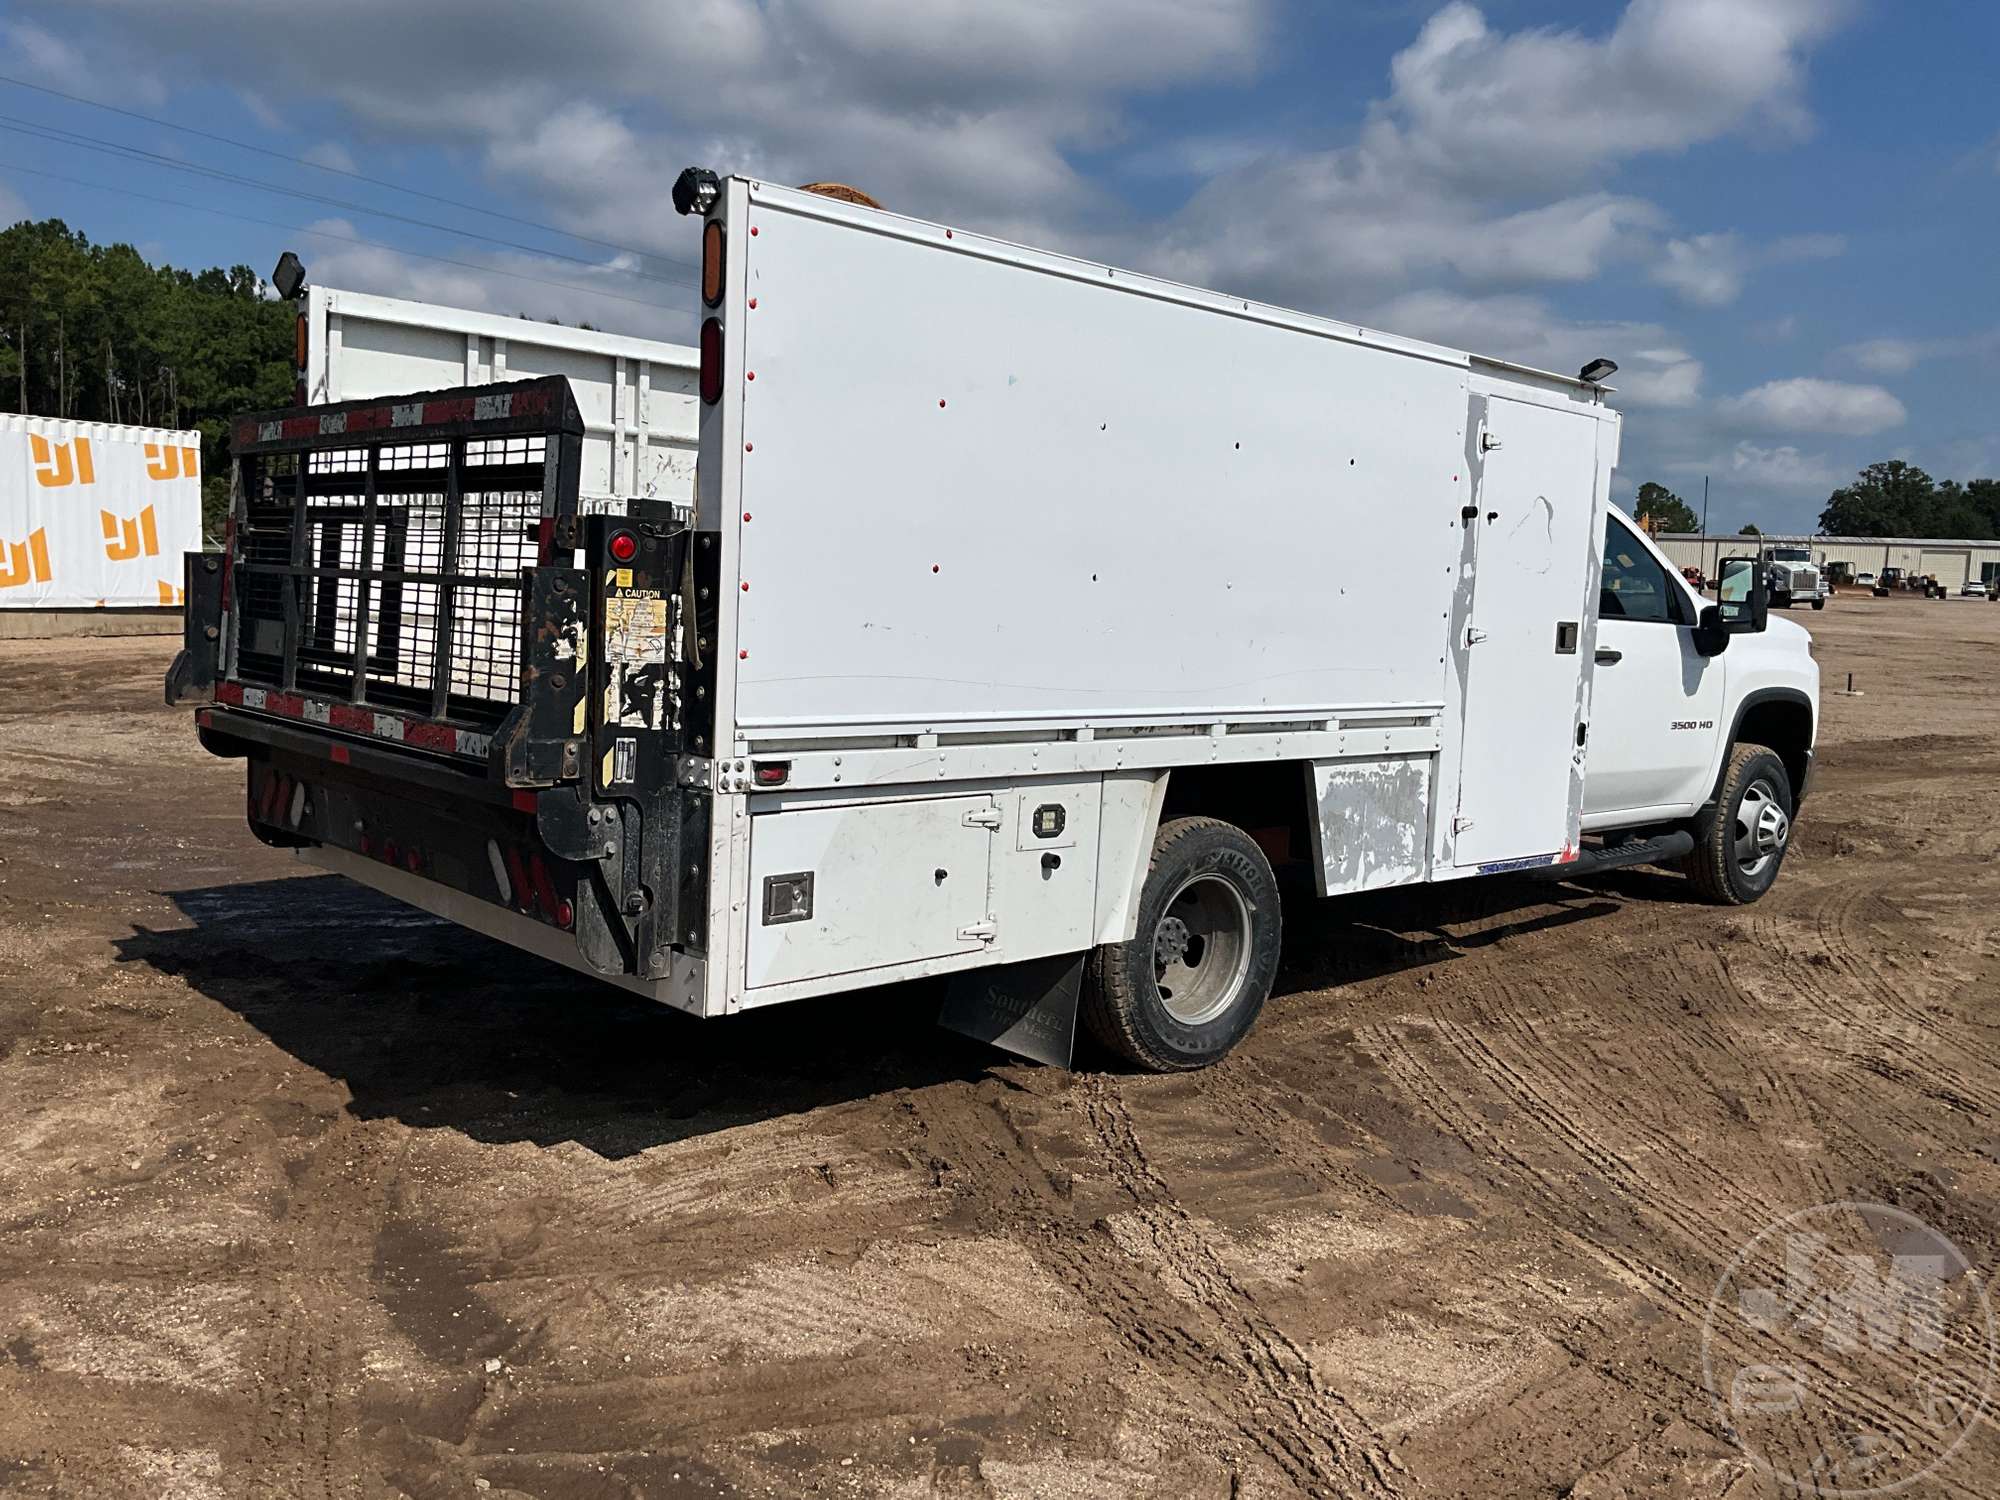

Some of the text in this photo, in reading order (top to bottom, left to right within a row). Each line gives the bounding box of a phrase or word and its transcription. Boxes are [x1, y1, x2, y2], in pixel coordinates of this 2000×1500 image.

[625, 589, 660, 599] CAUTION
[1670, 720, 1713, 730] 3500 HD
